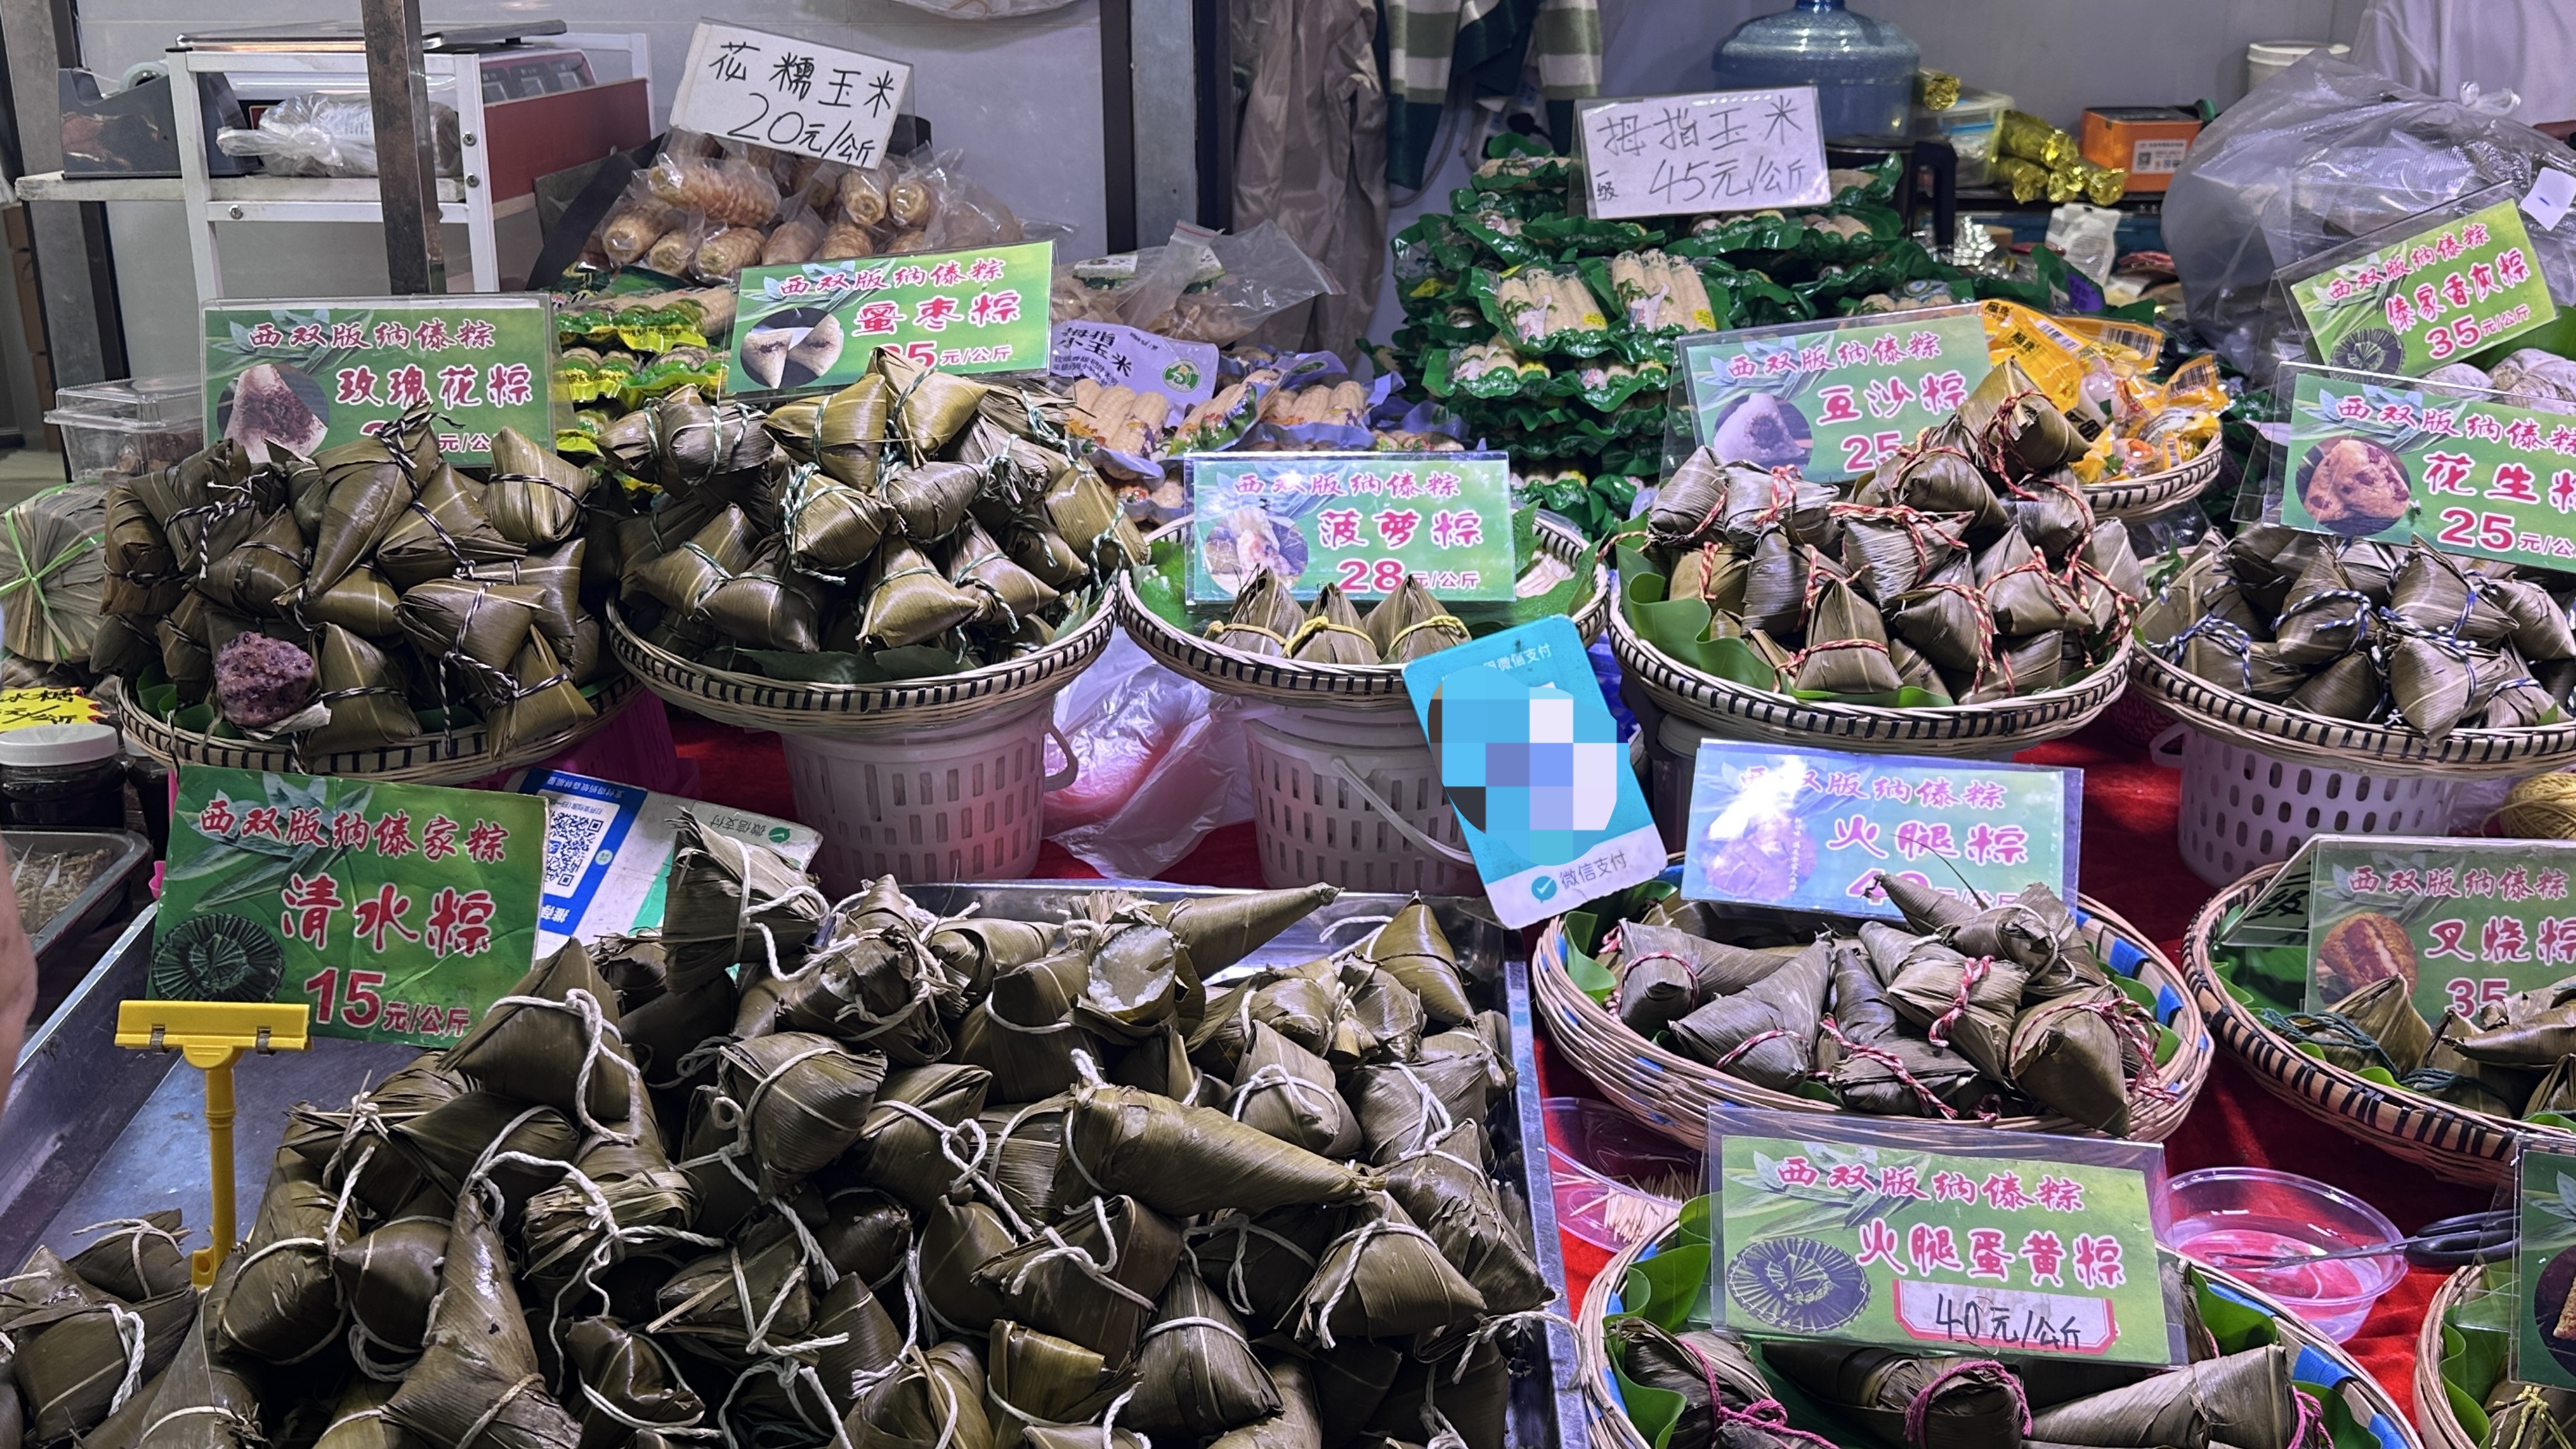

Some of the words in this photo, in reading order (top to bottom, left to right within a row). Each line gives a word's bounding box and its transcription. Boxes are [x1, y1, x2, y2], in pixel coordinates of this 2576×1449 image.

[709, 42, 894, 119] 花糯玉米
[1596, 94, 1804, 158] 拇指玉米
[779, 259, 1007, 296] 西双版纳傣粽
[2329, 223, 2492, 301] 西双版纳傣粽
[249, 318, 496, 350] 西双版纳傣粽
[852, 292, 1023, 337] 蜜枣粽
[884, 341, 1013, 369] 5元/公斤
[1726, 332, 1942, 379] 西双版纳傣粽
[335, 364, 534, 409] 玫瑰花粽
[1816, 371, 1968, 427] 豆沙粽
[1317, 509, 1484, 550] 菠萝粽
[200, 799, 510, 863] 西双版纳傣家粽
[710, 815, 767, 838] 微信支付
[1827, 814, 2030, 866] 火腿粽
[1559, 850, 1628, 891] 微信支付
[2348, 864, 2570, 901] 西双版纳傣粽
[281, 872, 498, 960] 清水粽
[1776, 1156, 2086, 1214] 西双版纳傣粽
[1856, 1217, 2127, 1289] 火腿蛋黄粽
[1936, 1292, 2082, 1351] 40元/公斤
